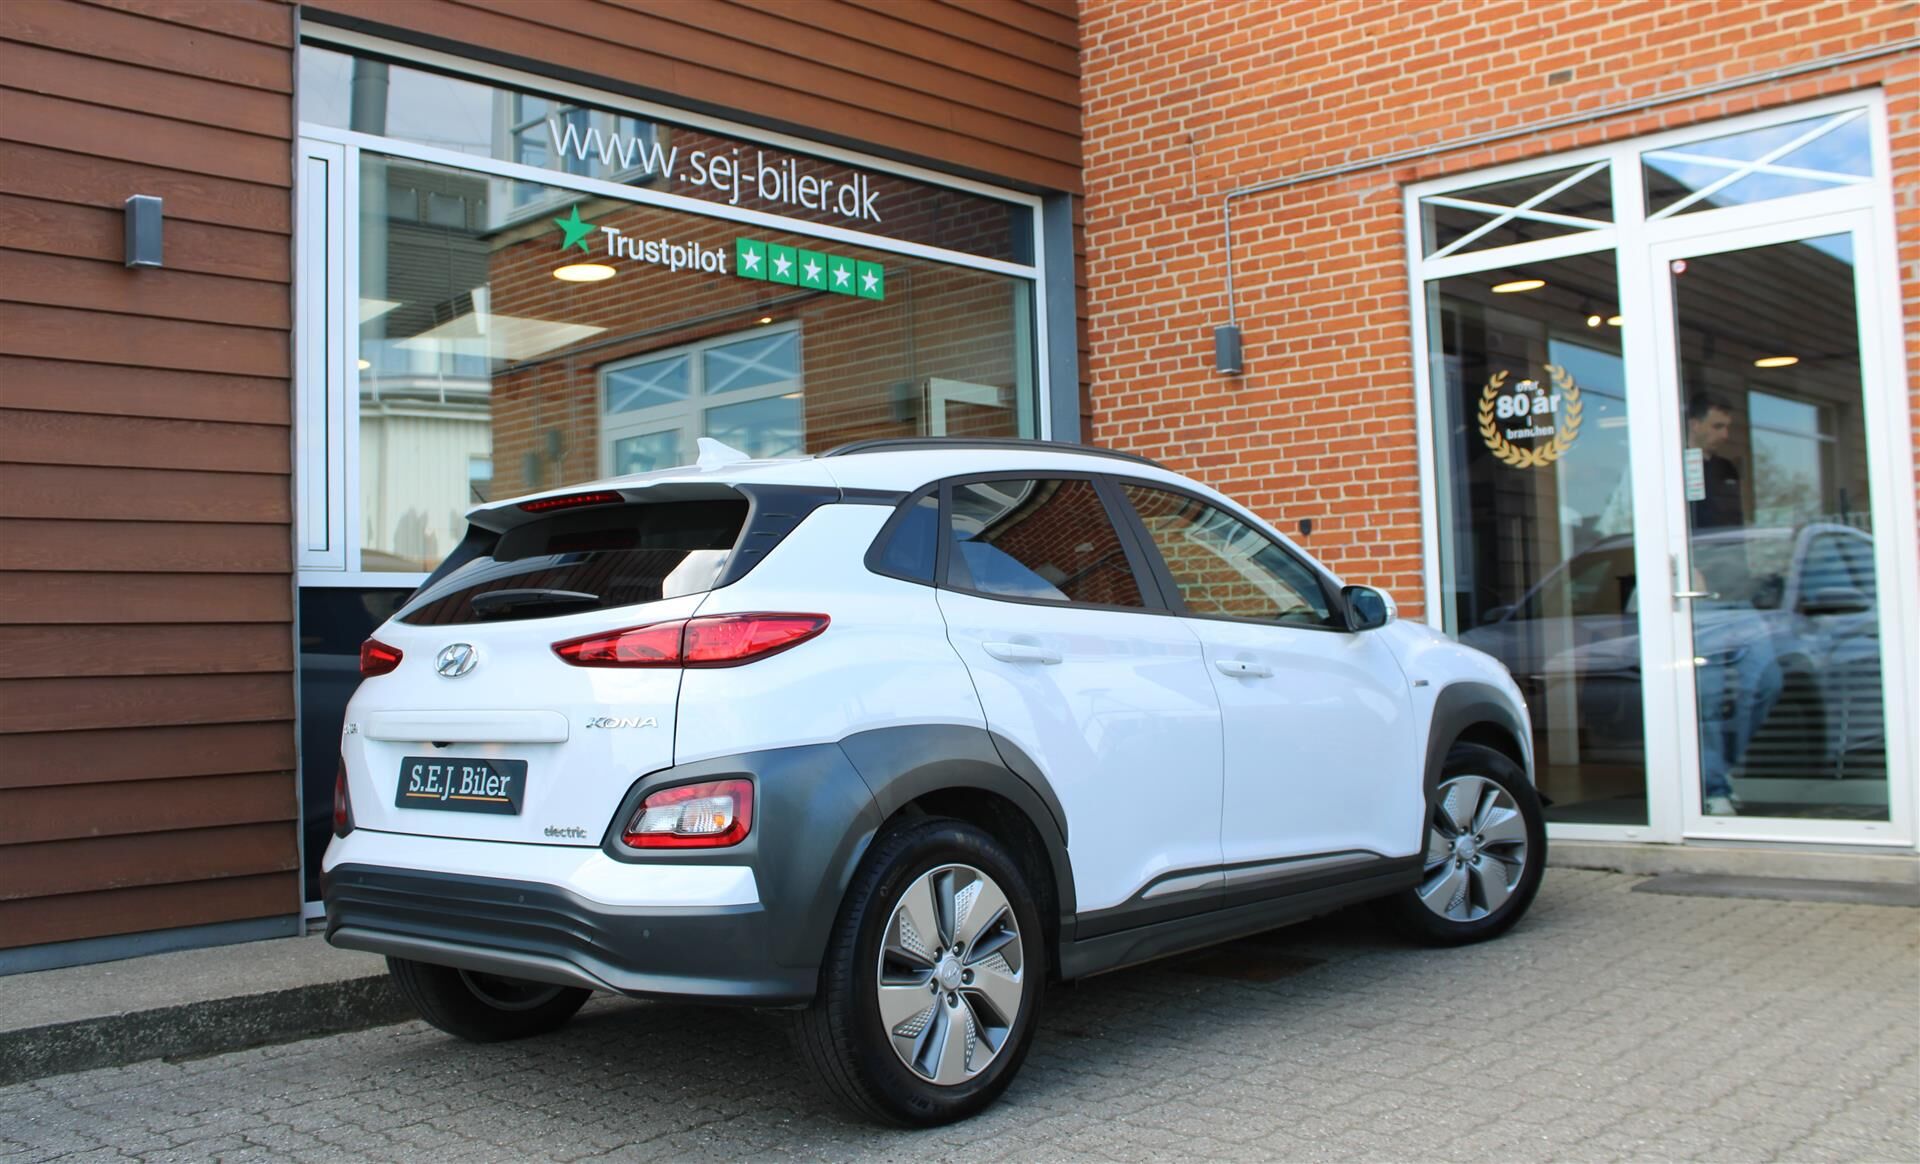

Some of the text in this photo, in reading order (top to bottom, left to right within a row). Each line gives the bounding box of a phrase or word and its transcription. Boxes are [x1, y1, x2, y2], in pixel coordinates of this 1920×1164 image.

[550, 119, 882, 222] www.sej-biler.dk
[601, 226, 727, 274] Trustpilot
[1496, 388, 1561, 418] 80 år
[1506, 425, 1554, 440] branchen
[585, 716, 658, 729] KONA
[409, 764, 511, 800] S.E.J. Biler
[544, 826, 587, 839] electric
